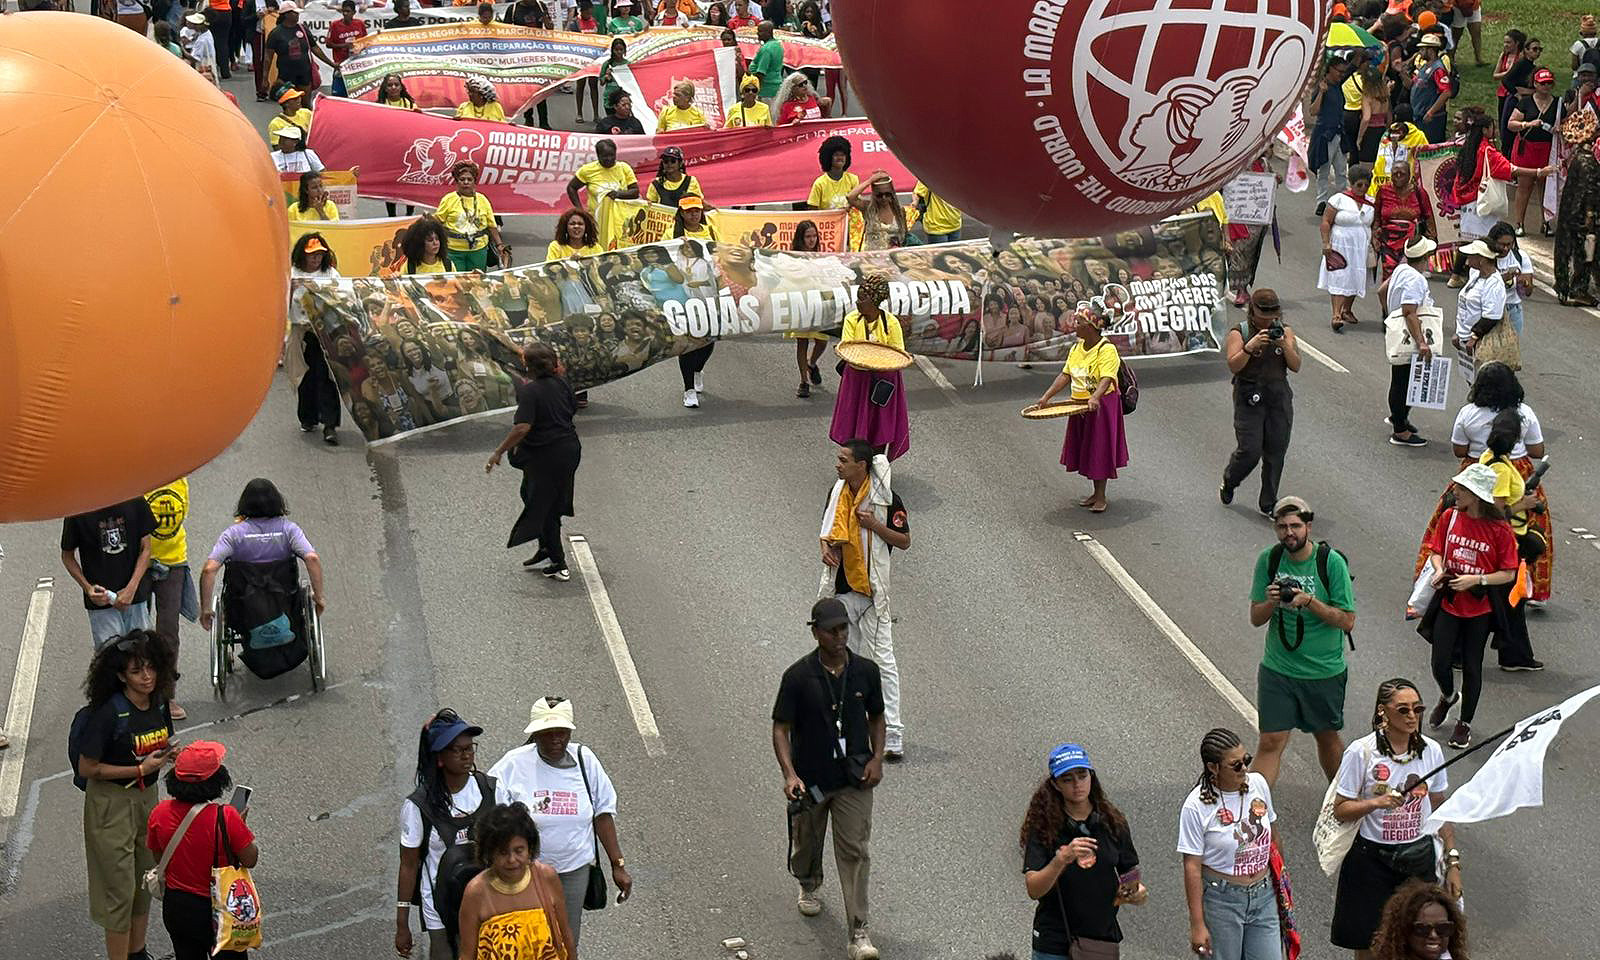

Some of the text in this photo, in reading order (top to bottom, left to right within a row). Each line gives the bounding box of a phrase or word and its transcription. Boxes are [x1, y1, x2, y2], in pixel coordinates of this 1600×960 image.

[304, 19, 372, 30] MULS
[428, 28, 468, 39] NEGRAS
[496, 27, 535, 37] MARCHA
[422, 42, 469, 53] MARCHAR
[470, 42, 491, 50] POR
[492, 41, 545, 51] REPARAÇÃO
[460, 57, 493, 66] MUNDO
[499, 55, 545, 65] MULHERES
[403, 69, 437, 77] MENOS
[1023, 68, 1053, 97] LA
[488, 131, 599, 151] MARCHA DAS
[1033, 114, 1086, 180] WORLD
[1074, 174, 1113, 205] THE
[1104, 193, 1177, 215] AROUND
[648, 209, 676, 224] MARC
[780, 220, 836, 231] MAR DAS
[780, 230, 836, 242] MURES
[1130, 272, 1217, 296] MARCHA DAS
[1135, 286, 1220, 311] MULHERES
[662, 279, 971, 338] GOIÁS EM MRCHA
[1138, 304, 1212, 334] NEGRA
[1382, 820, 1421, 830] MULHERES
[1382, 828, 1420, 841] NEGRAS
